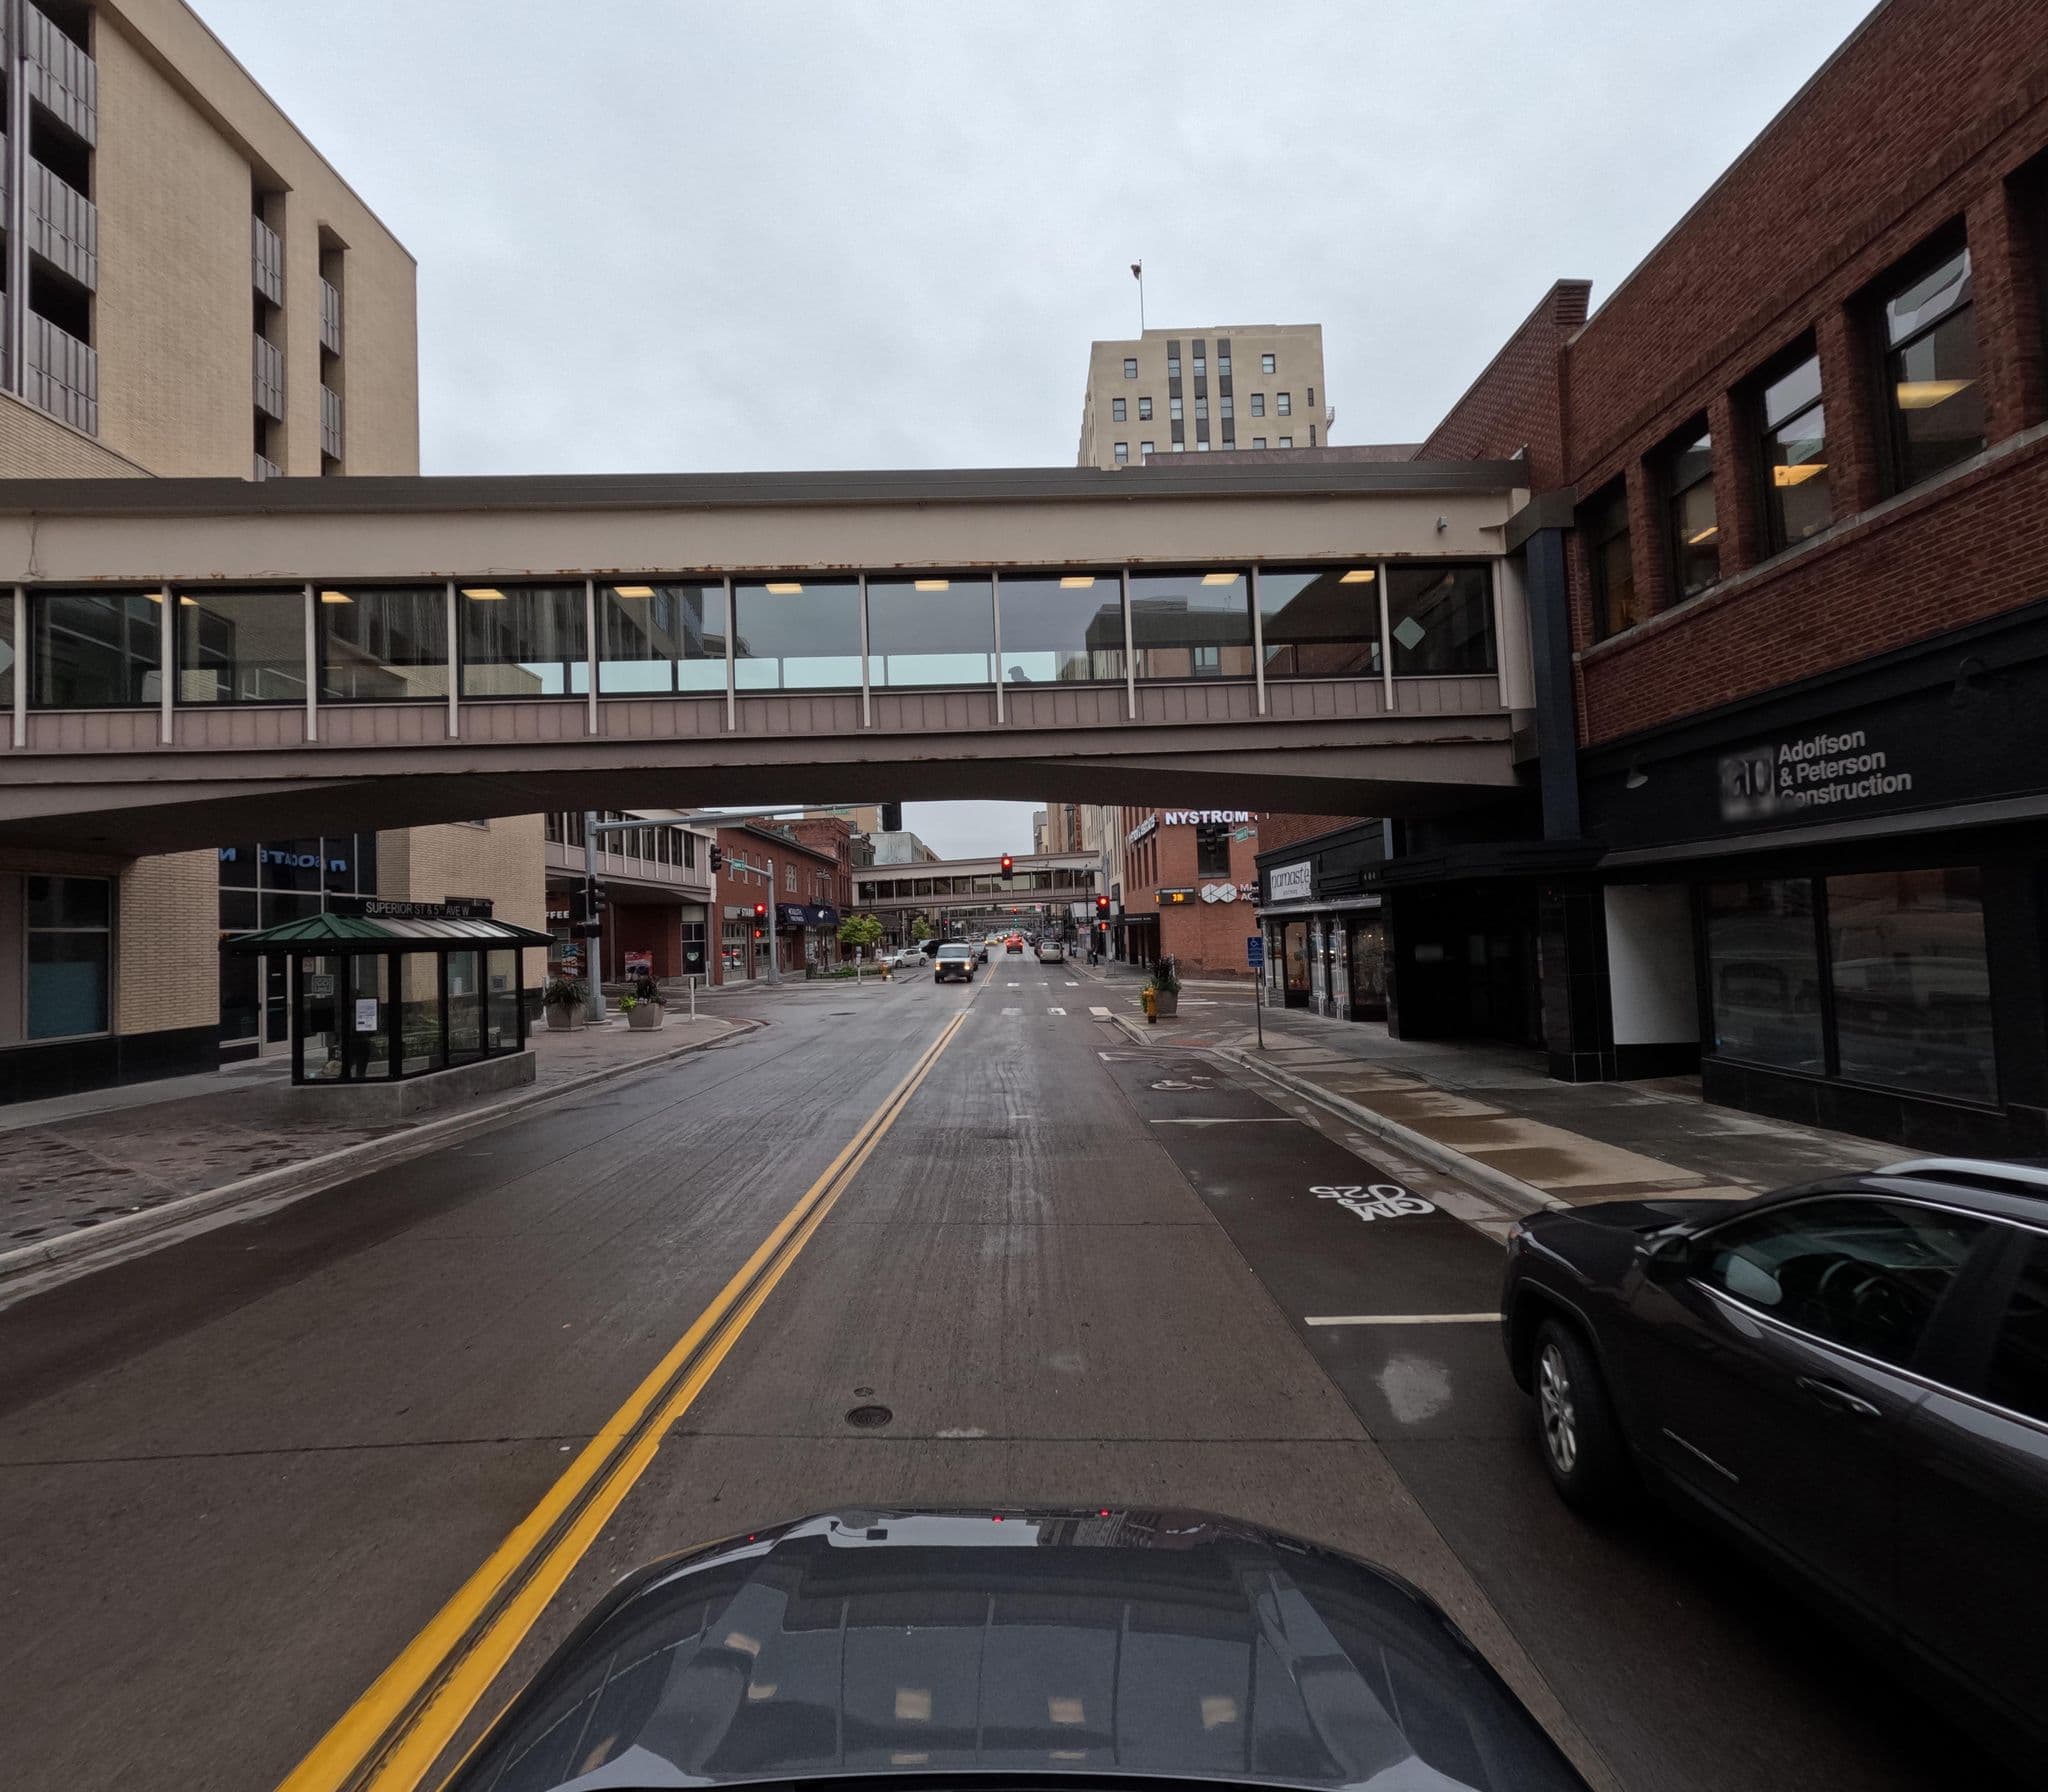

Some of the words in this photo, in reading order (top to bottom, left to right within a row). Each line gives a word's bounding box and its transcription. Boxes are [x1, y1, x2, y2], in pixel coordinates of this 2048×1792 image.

[1778, 730, 1866, 764] Adolfson
[1779, 766, 1794, 788] &
[1796, 751, 1886, 784] Peterson
[1164, 810, 1249, 825] NYSTROM
[366, 901, 413, 914] SUPERIOR
[414, 903, 425, 915] ST
[447, 905, 461, 917] AVE
[461, 905, 470, 916] W
